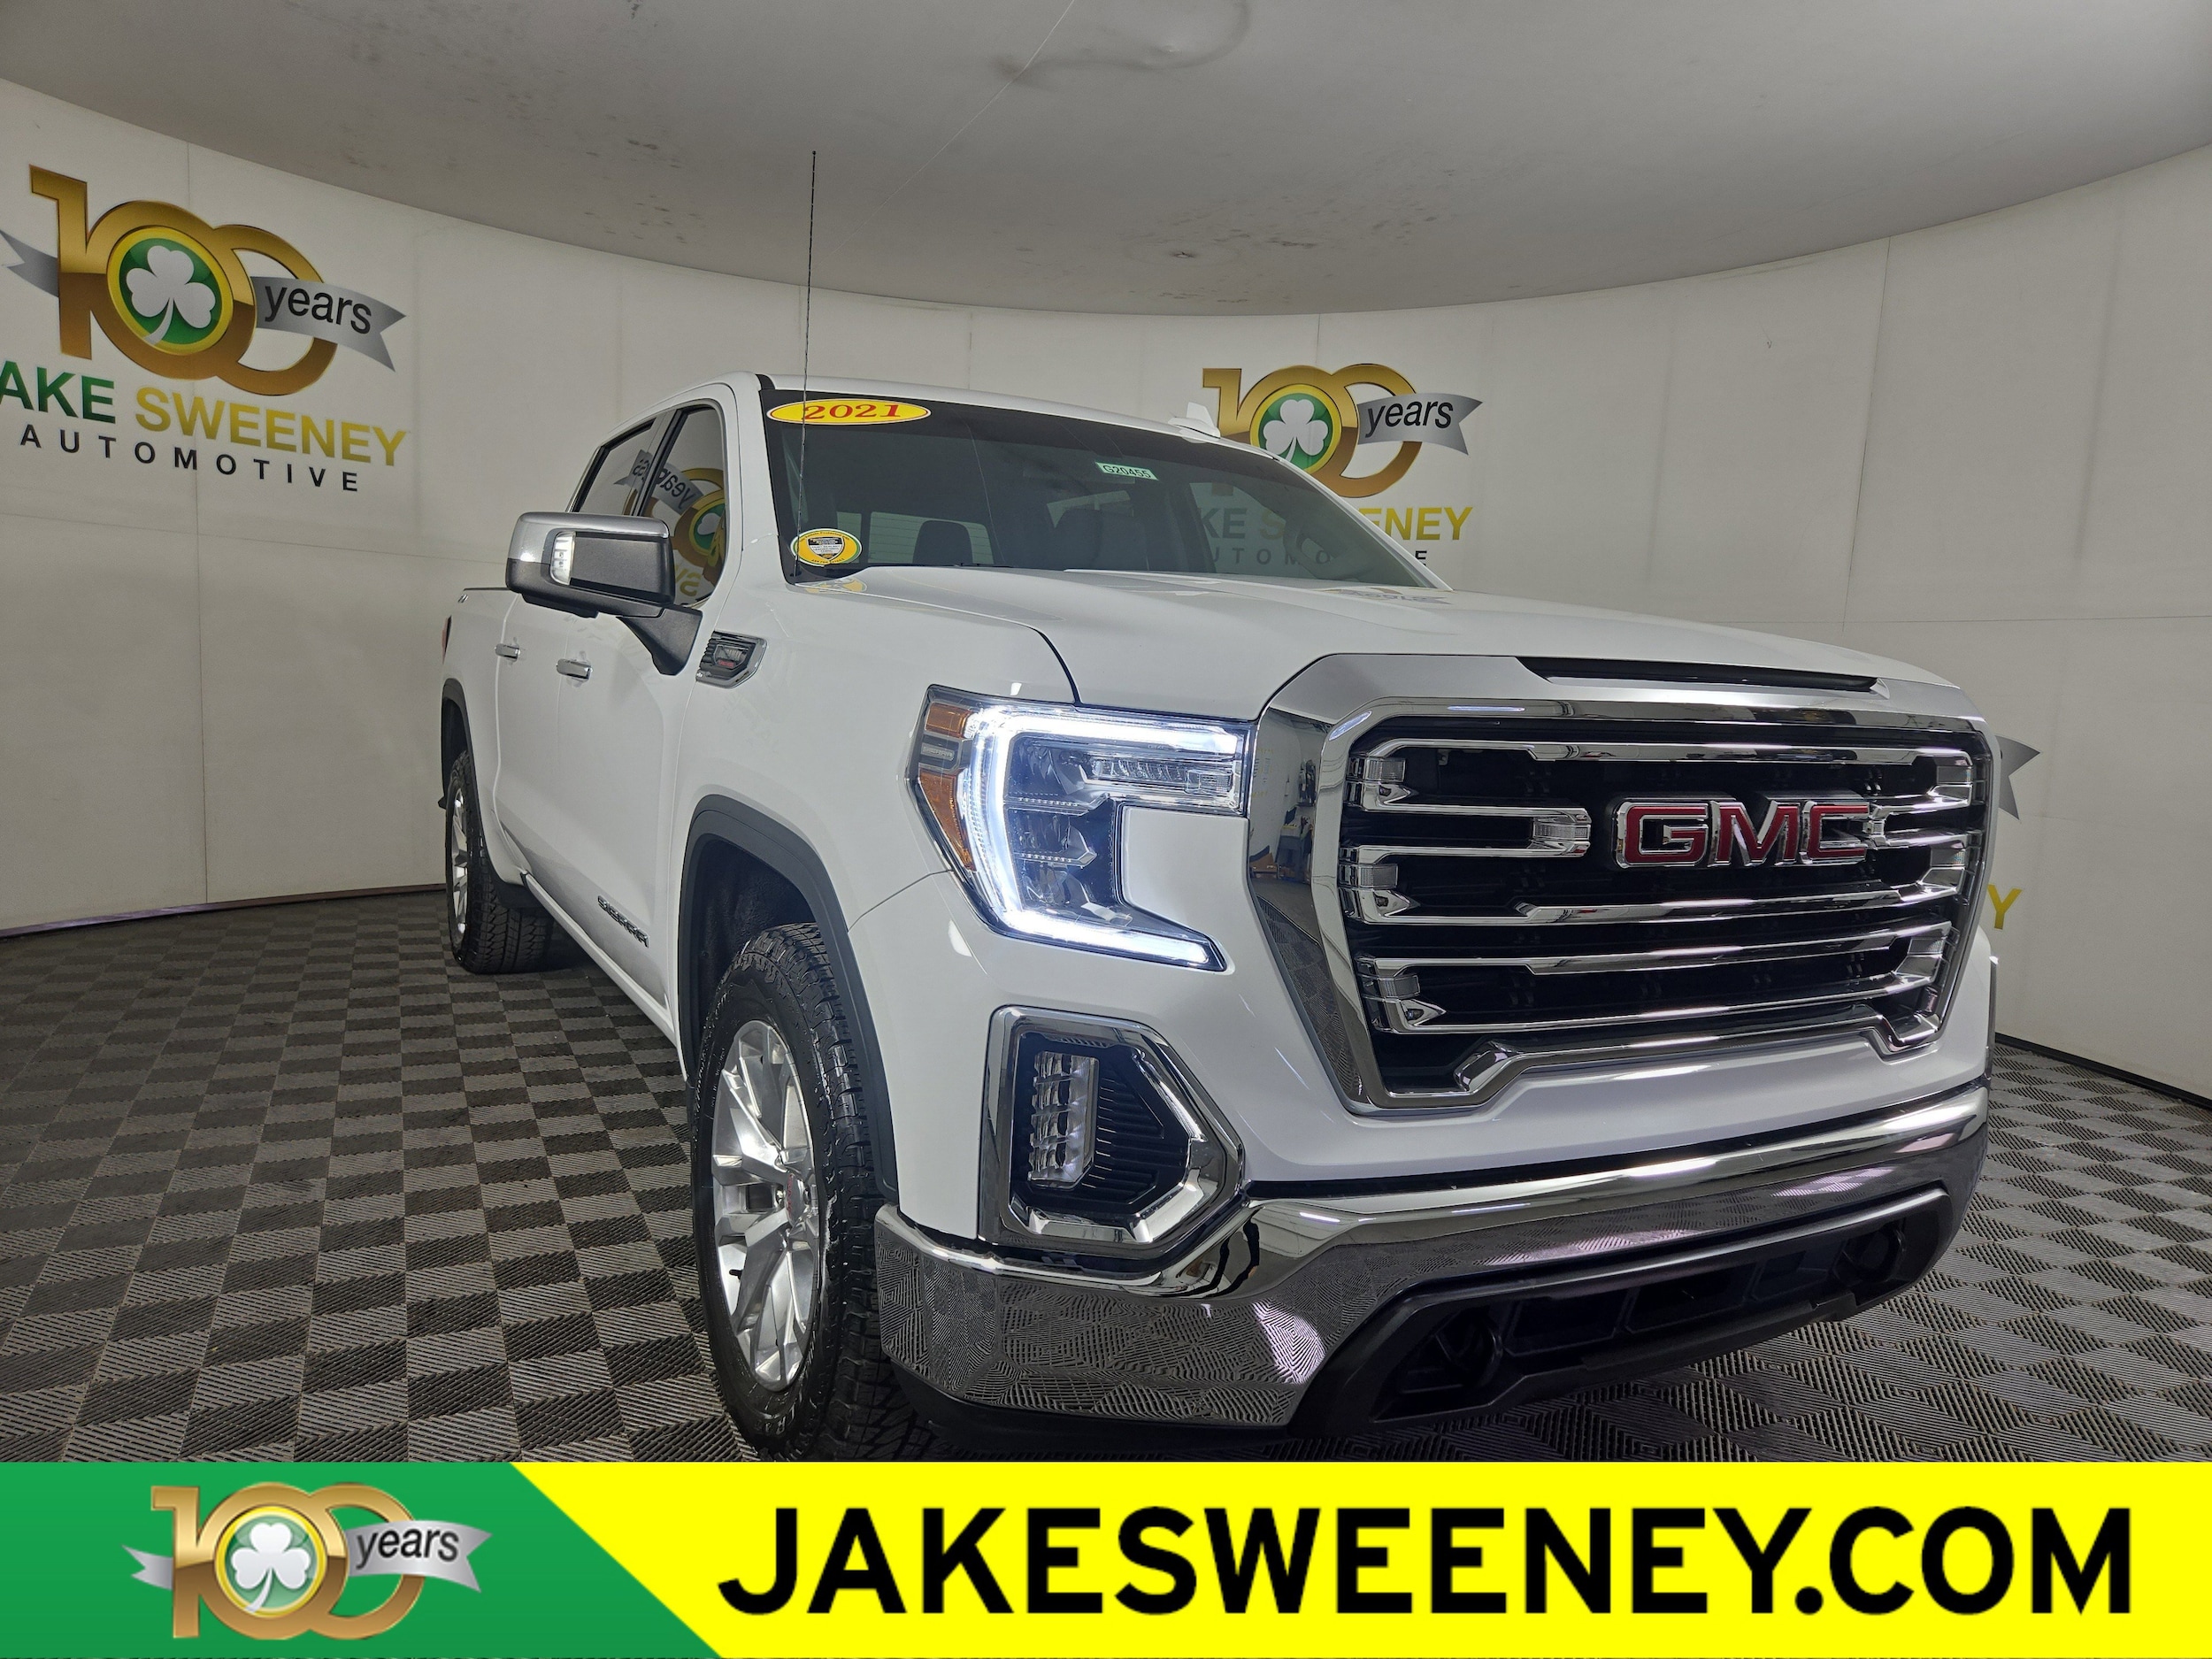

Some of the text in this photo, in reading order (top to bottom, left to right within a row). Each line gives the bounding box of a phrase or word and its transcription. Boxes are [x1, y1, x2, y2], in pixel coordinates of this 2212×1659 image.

[28, 164, 373, 396] 100 years
[0, 359, 407, 467] AKE SWEENEY
[802, 403, 902, 421] 2021
[1364, 398, 1455, 439] years
[19, 423, 359, 493] AUTOMOTIVE
[1102, 465, 1152, 479] G20455
[1616, 800, 1870, 869] GMC
